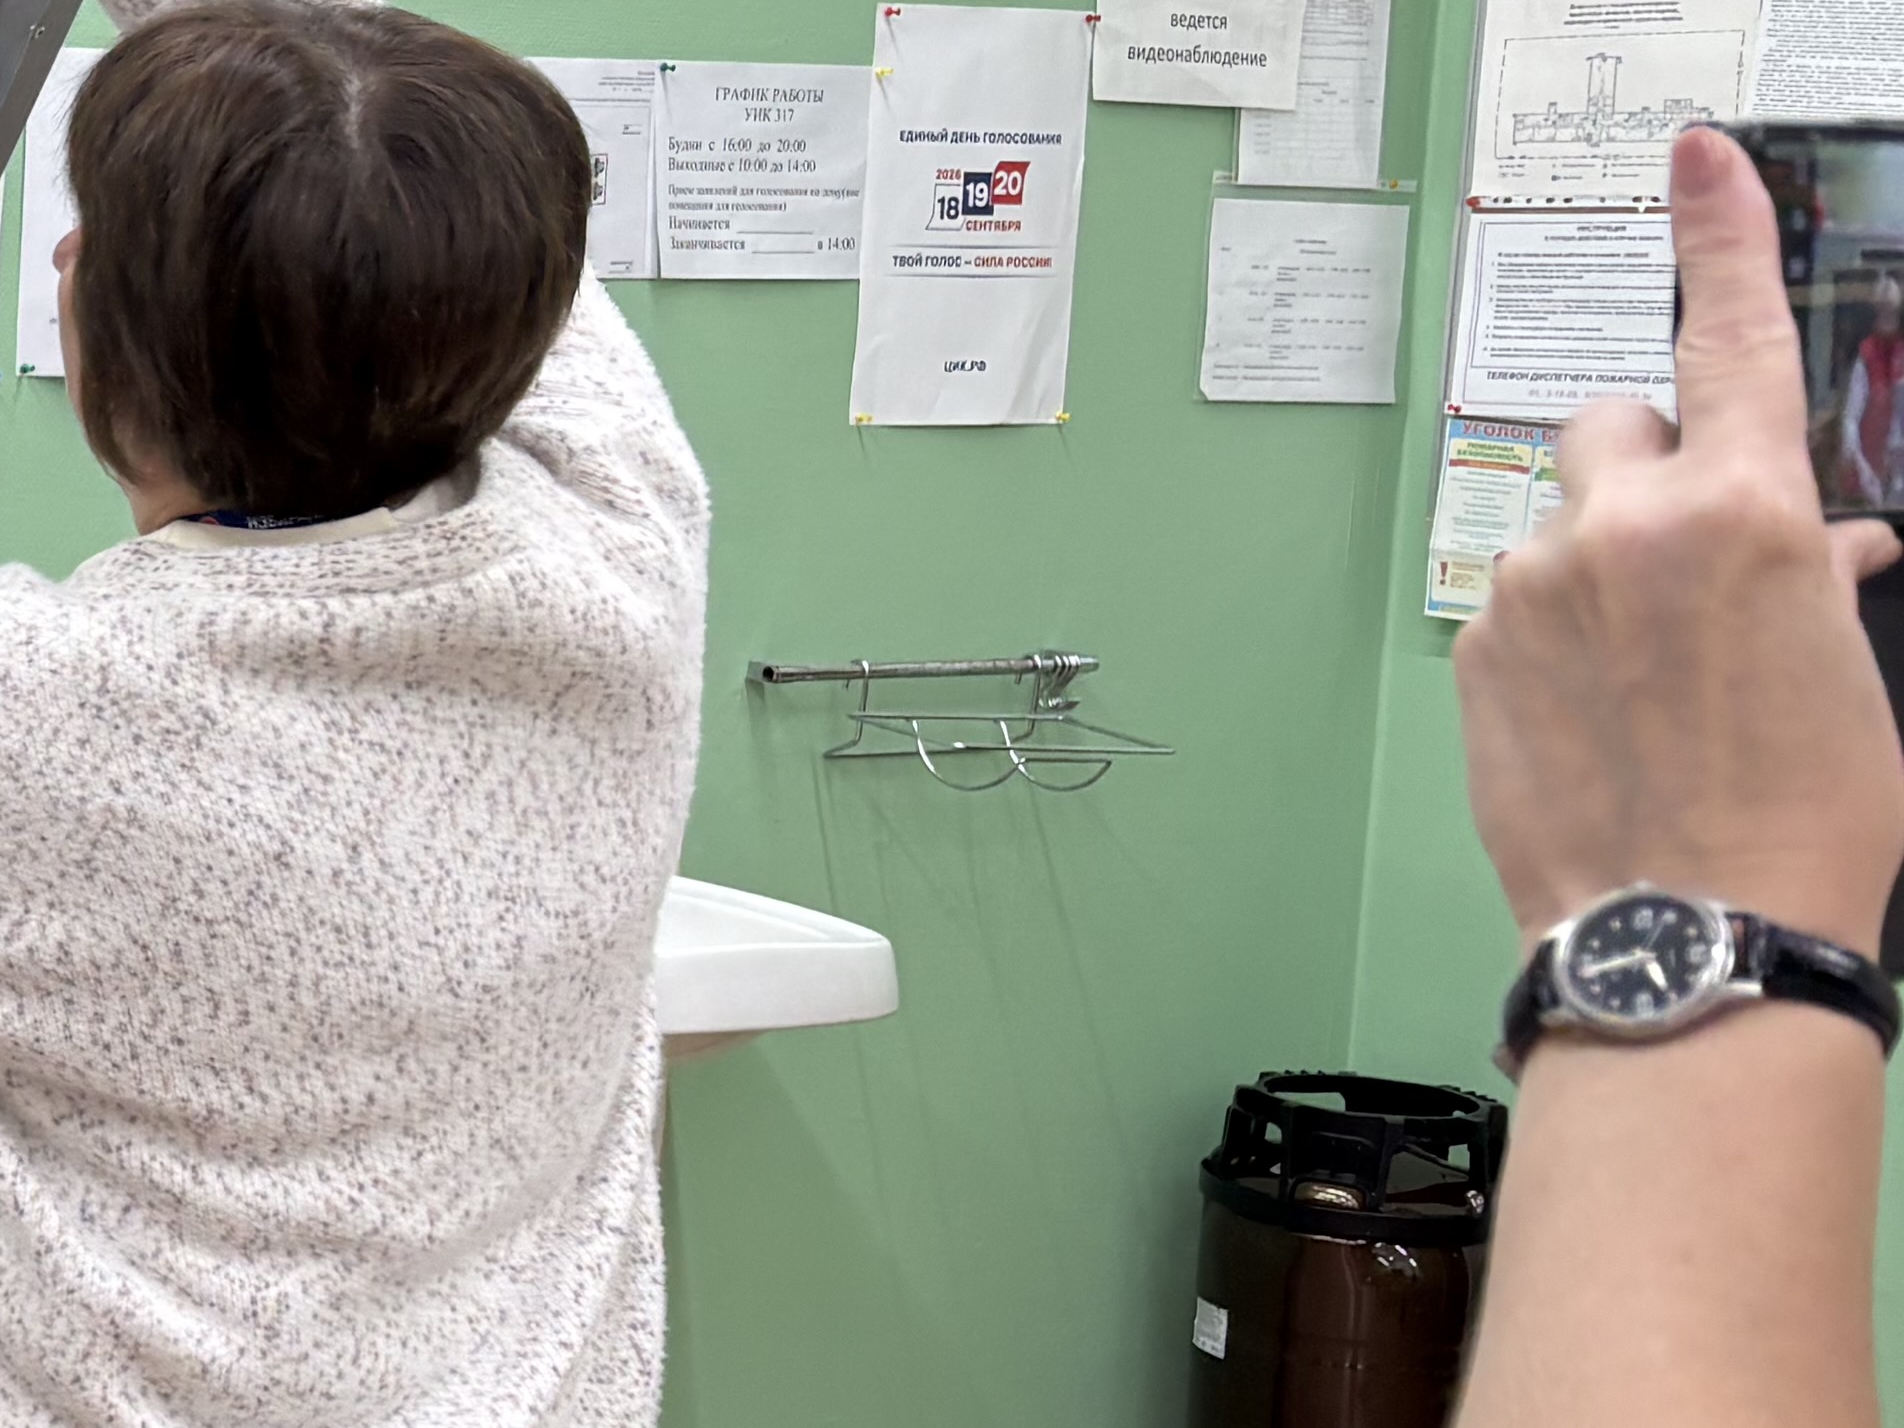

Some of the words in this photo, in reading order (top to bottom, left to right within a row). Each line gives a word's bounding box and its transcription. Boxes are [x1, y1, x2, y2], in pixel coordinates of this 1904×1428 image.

[1170, 12, 1228, 32] ведется
[1127, 45, 1268, 69] видеонаблюдение
[715, 86, 768, 103] ГРАФИК
[772, 88, 824, 103] РАБОТЫ
[744, 108, 772, 123] УИК
[774, 108, 794, 122] 317
[899, 128, 948, 143] ЕДИНЫЙ
[950, 130, 980, 145] ДЕНЬ
[982, 131, 1062, 145] ГОЛОСОВАНИЯ
[994, 170, 1023, 196] 20
[965, 182, 989, 208] 19
[937, 196, 960, 221] 18
[965, 220, 1022, 232] СЕНТЯБРЯ
[892, 253, 923, 268] ТВОЙ
[925, 255, 962, 268] ГОЛОС
[974, 256, 1004, 268] СИЛА
